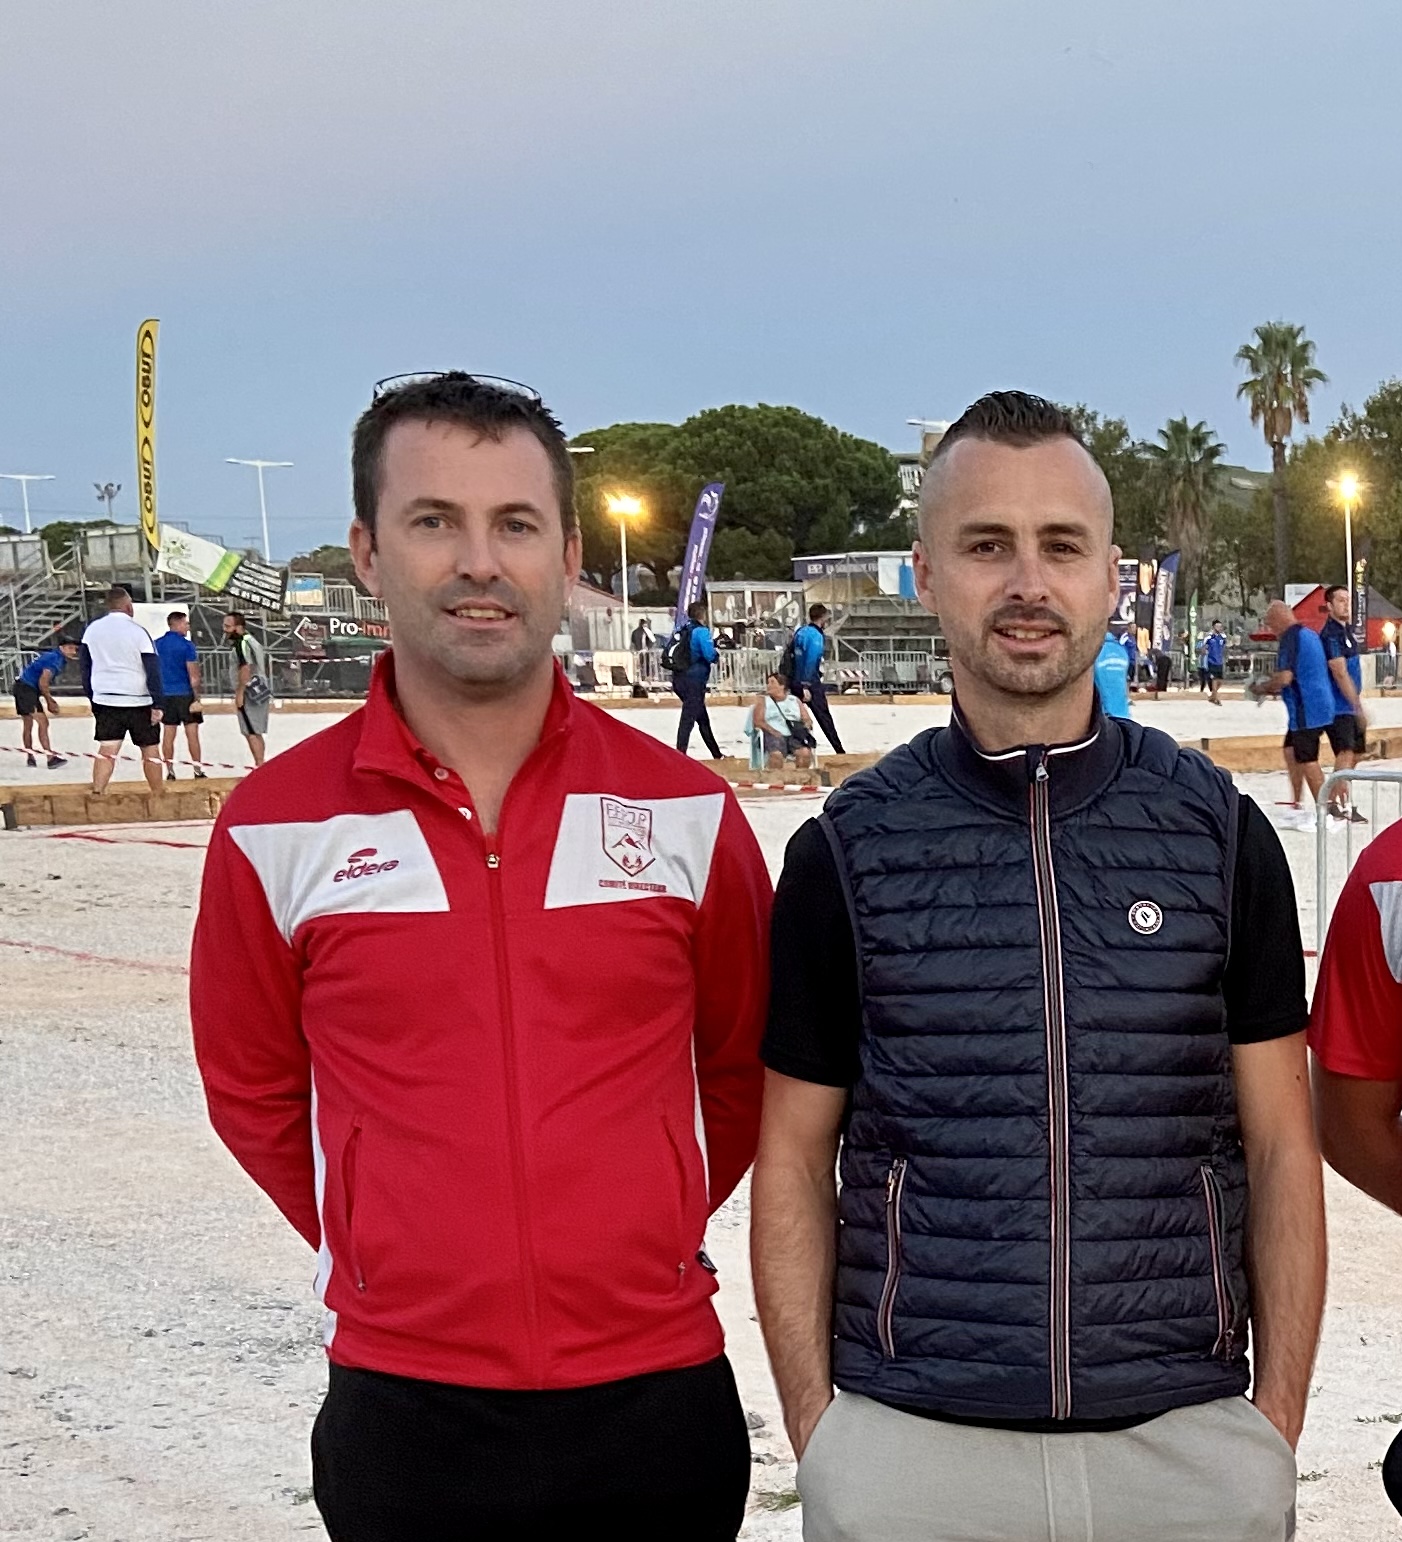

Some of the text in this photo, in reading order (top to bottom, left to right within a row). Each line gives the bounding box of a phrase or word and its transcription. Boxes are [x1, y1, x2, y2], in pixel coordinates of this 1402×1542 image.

[141, 352, 153, 408] OBUT
[143, 459, 153, 514] OBUT
[332, 859, 399, 883] eldera
